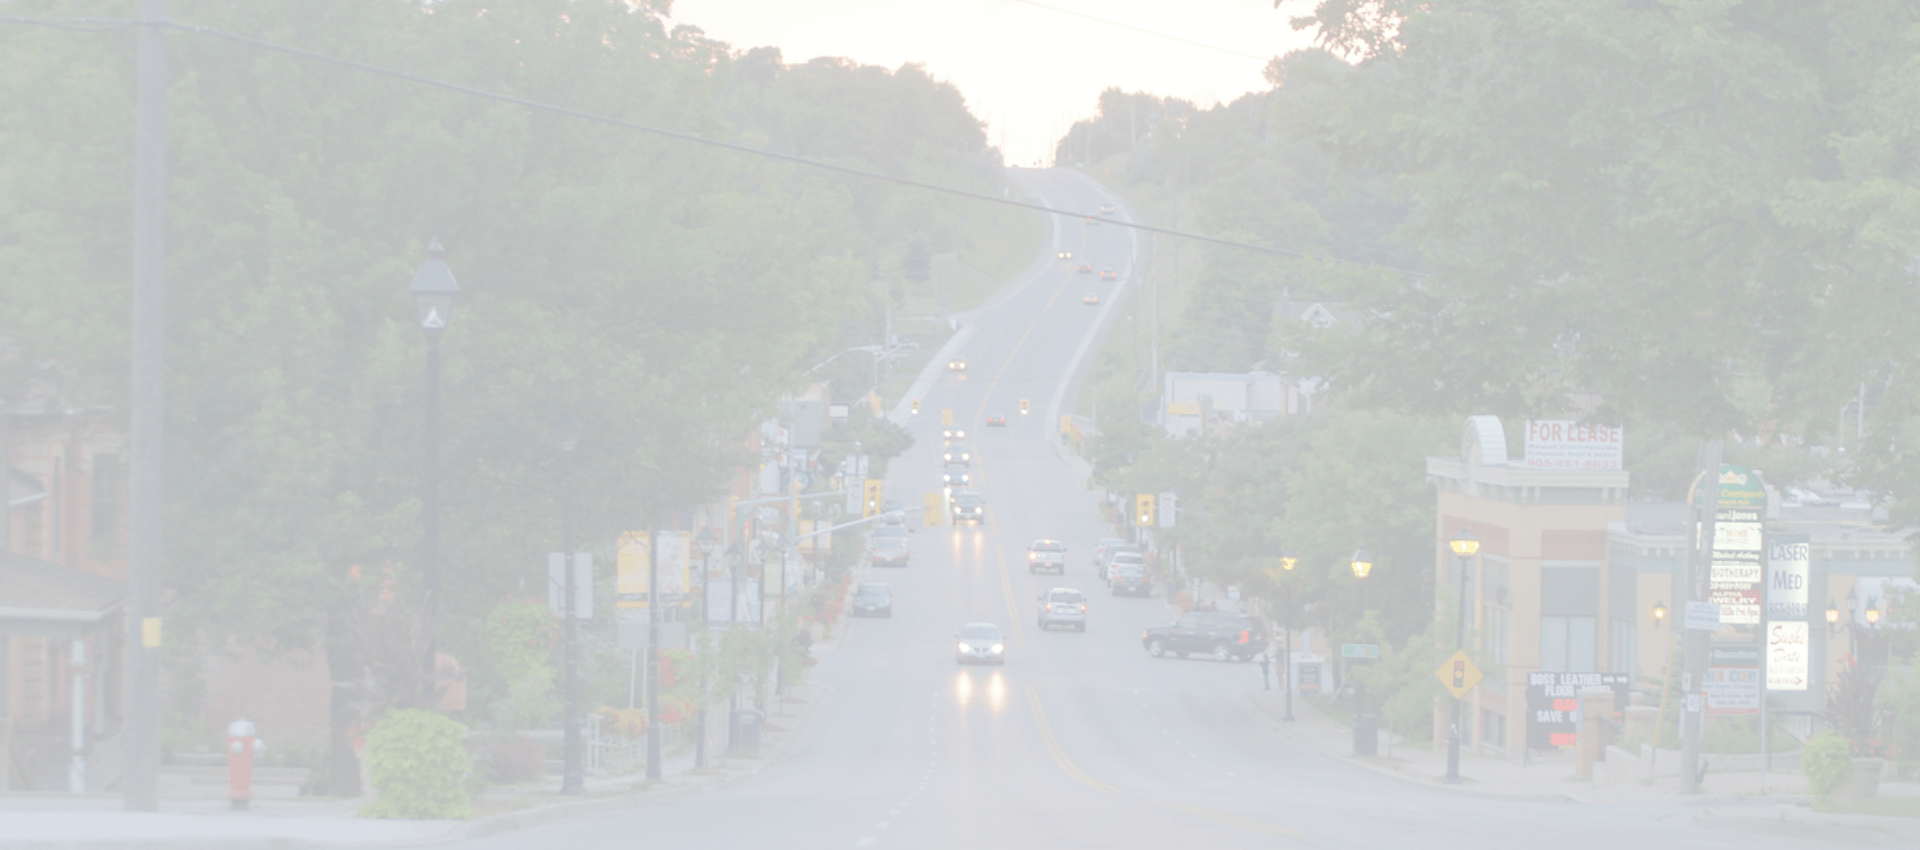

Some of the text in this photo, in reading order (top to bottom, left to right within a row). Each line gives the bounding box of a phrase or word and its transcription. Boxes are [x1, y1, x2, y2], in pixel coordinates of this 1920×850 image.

[1529, 423, 1619, 442] FOR LEASE
[1528, 459, 1617, 468] 905-951-6633
[1770, 540, 1807, 561] LASER
[1711, 568, 1759, 578] SIOTHERAPY
[1773, 570, 1803, 590] MED
[1769, 624, 1804, 645] Sushi
[1530, 673, 1602, 685] BOSS LEATHER
[1544, 685, 1575, 697] FLOOR
[1536, 710, 1577, 722] SAVE U
